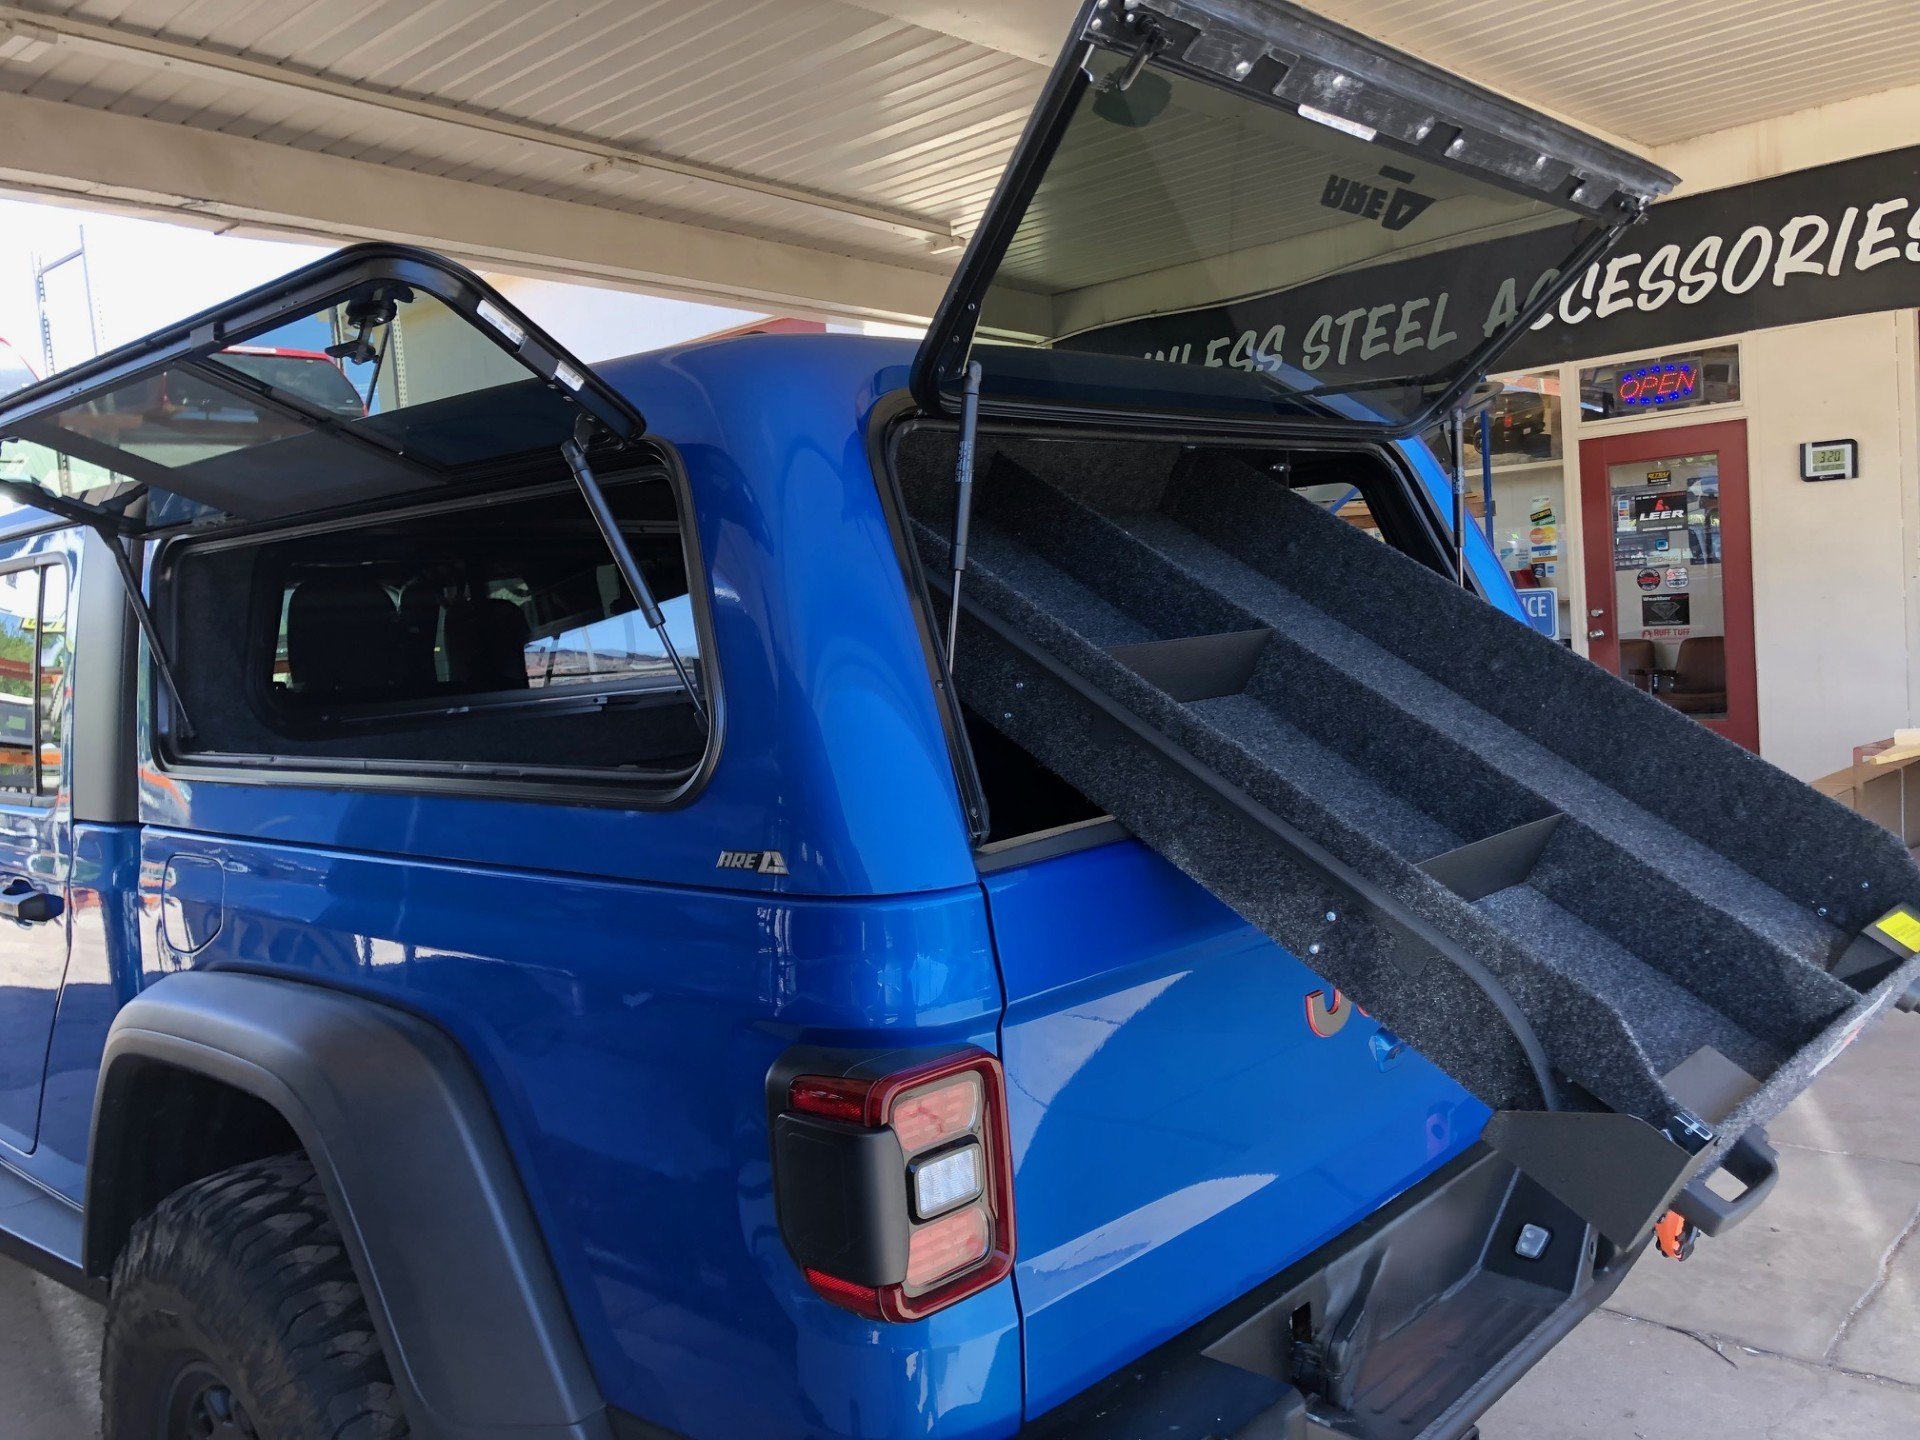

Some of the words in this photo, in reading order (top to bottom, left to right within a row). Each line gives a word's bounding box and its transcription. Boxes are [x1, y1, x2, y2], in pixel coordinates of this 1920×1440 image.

[1302, 294, 1457, 371] STEEL
[1482, 197, 1920, 338] ACCESSORIE
[1619, 368, 1698, 401] OPEN
[1639, 509, 1685, 522] LEER
[716, 850, 759, 869] ARE
